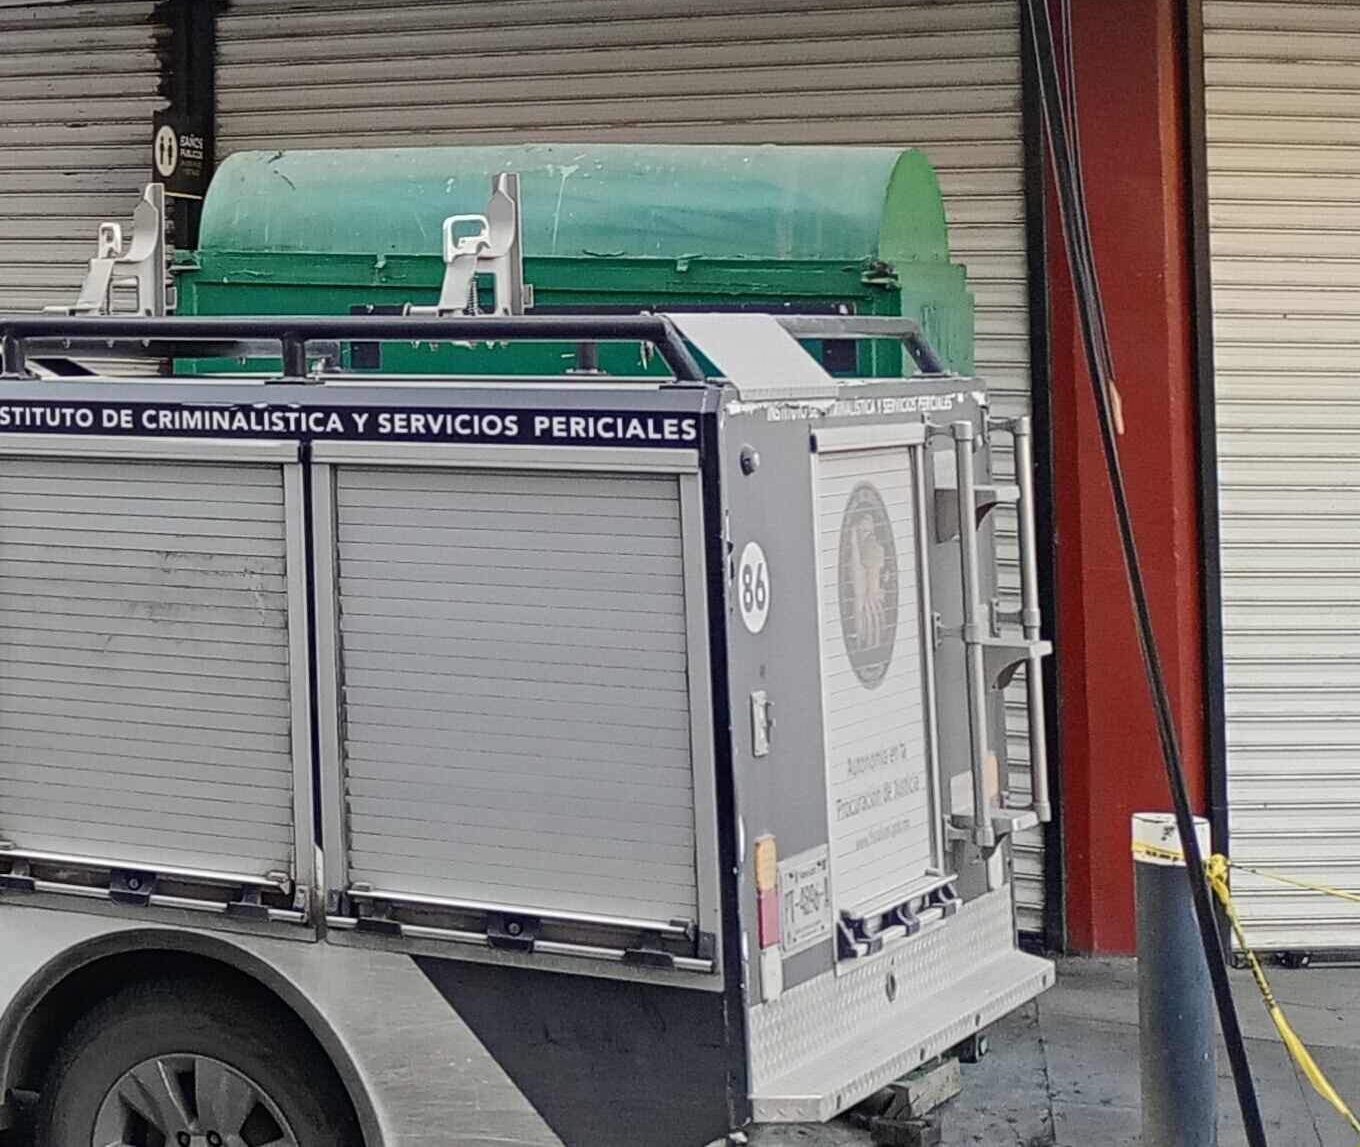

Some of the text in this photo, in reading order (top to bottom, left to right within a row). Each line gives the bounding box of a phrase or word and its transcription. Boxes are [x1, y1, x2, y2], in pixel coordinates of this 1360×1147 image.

[102, 408, 133, 429] DE
[352, 413, 369, 433] Y
[378, 413, 519, 436] SERVICIOS
[534, 416, 696, 440] PERICIALES
[742, 562, 765, 613] 86
